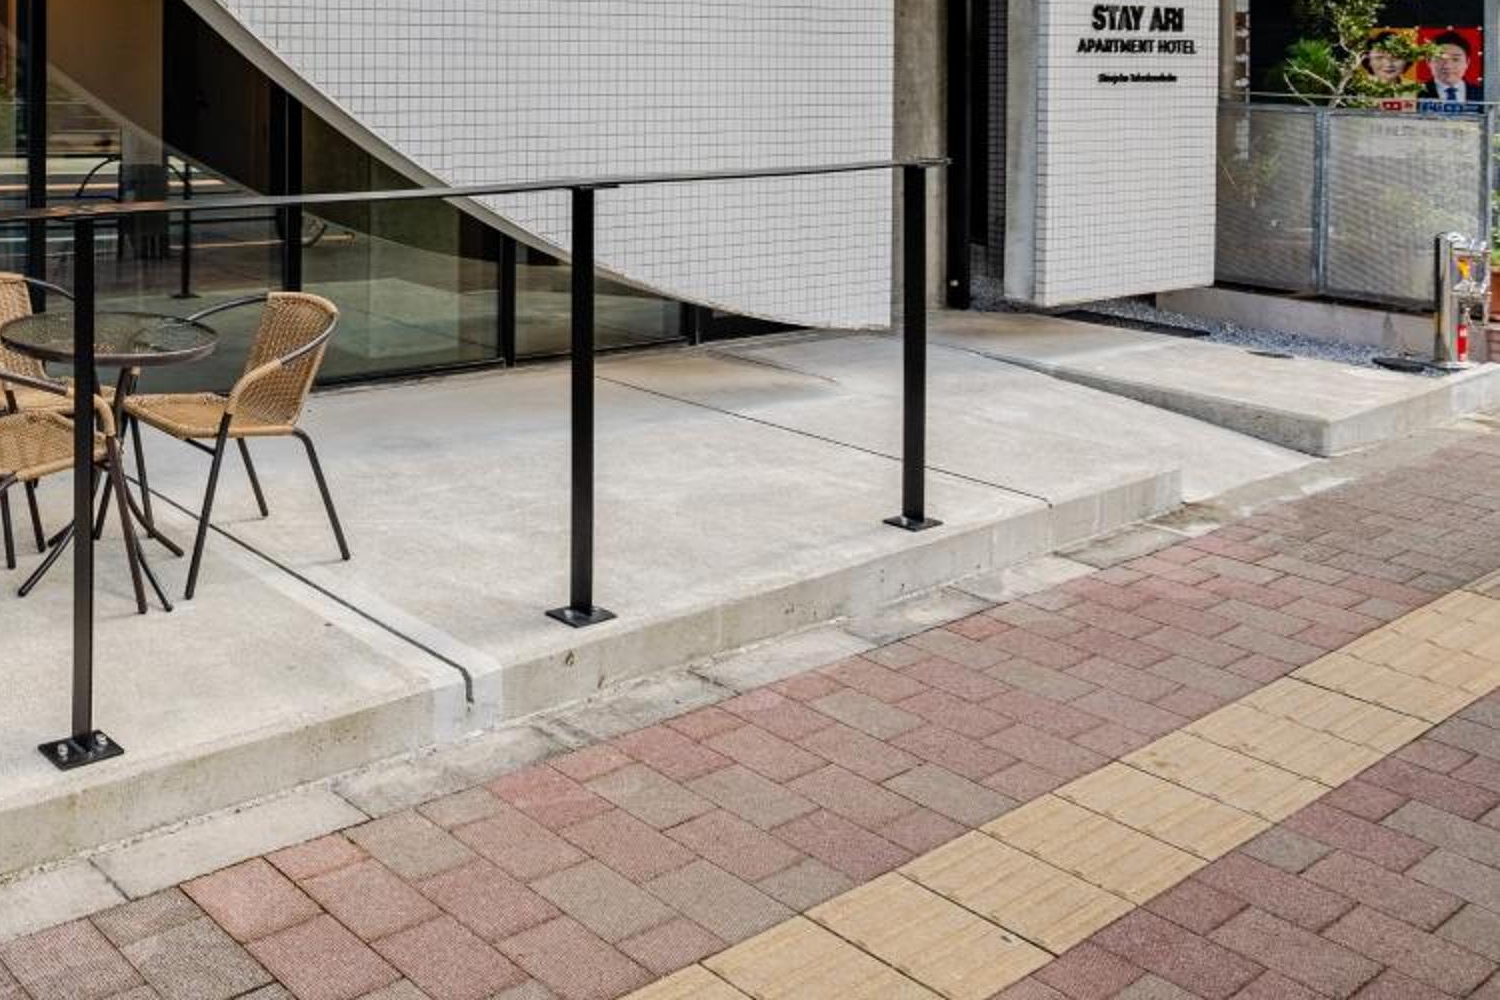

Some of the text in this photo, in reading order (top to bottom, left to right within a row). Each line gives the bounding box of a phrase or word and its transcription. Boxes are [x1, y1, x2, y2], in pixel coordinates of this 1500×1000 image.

[1092, 4, 1184, 32] STAY ARI
[1077, 38, 1196, 54] APARTMENT HOTEL
